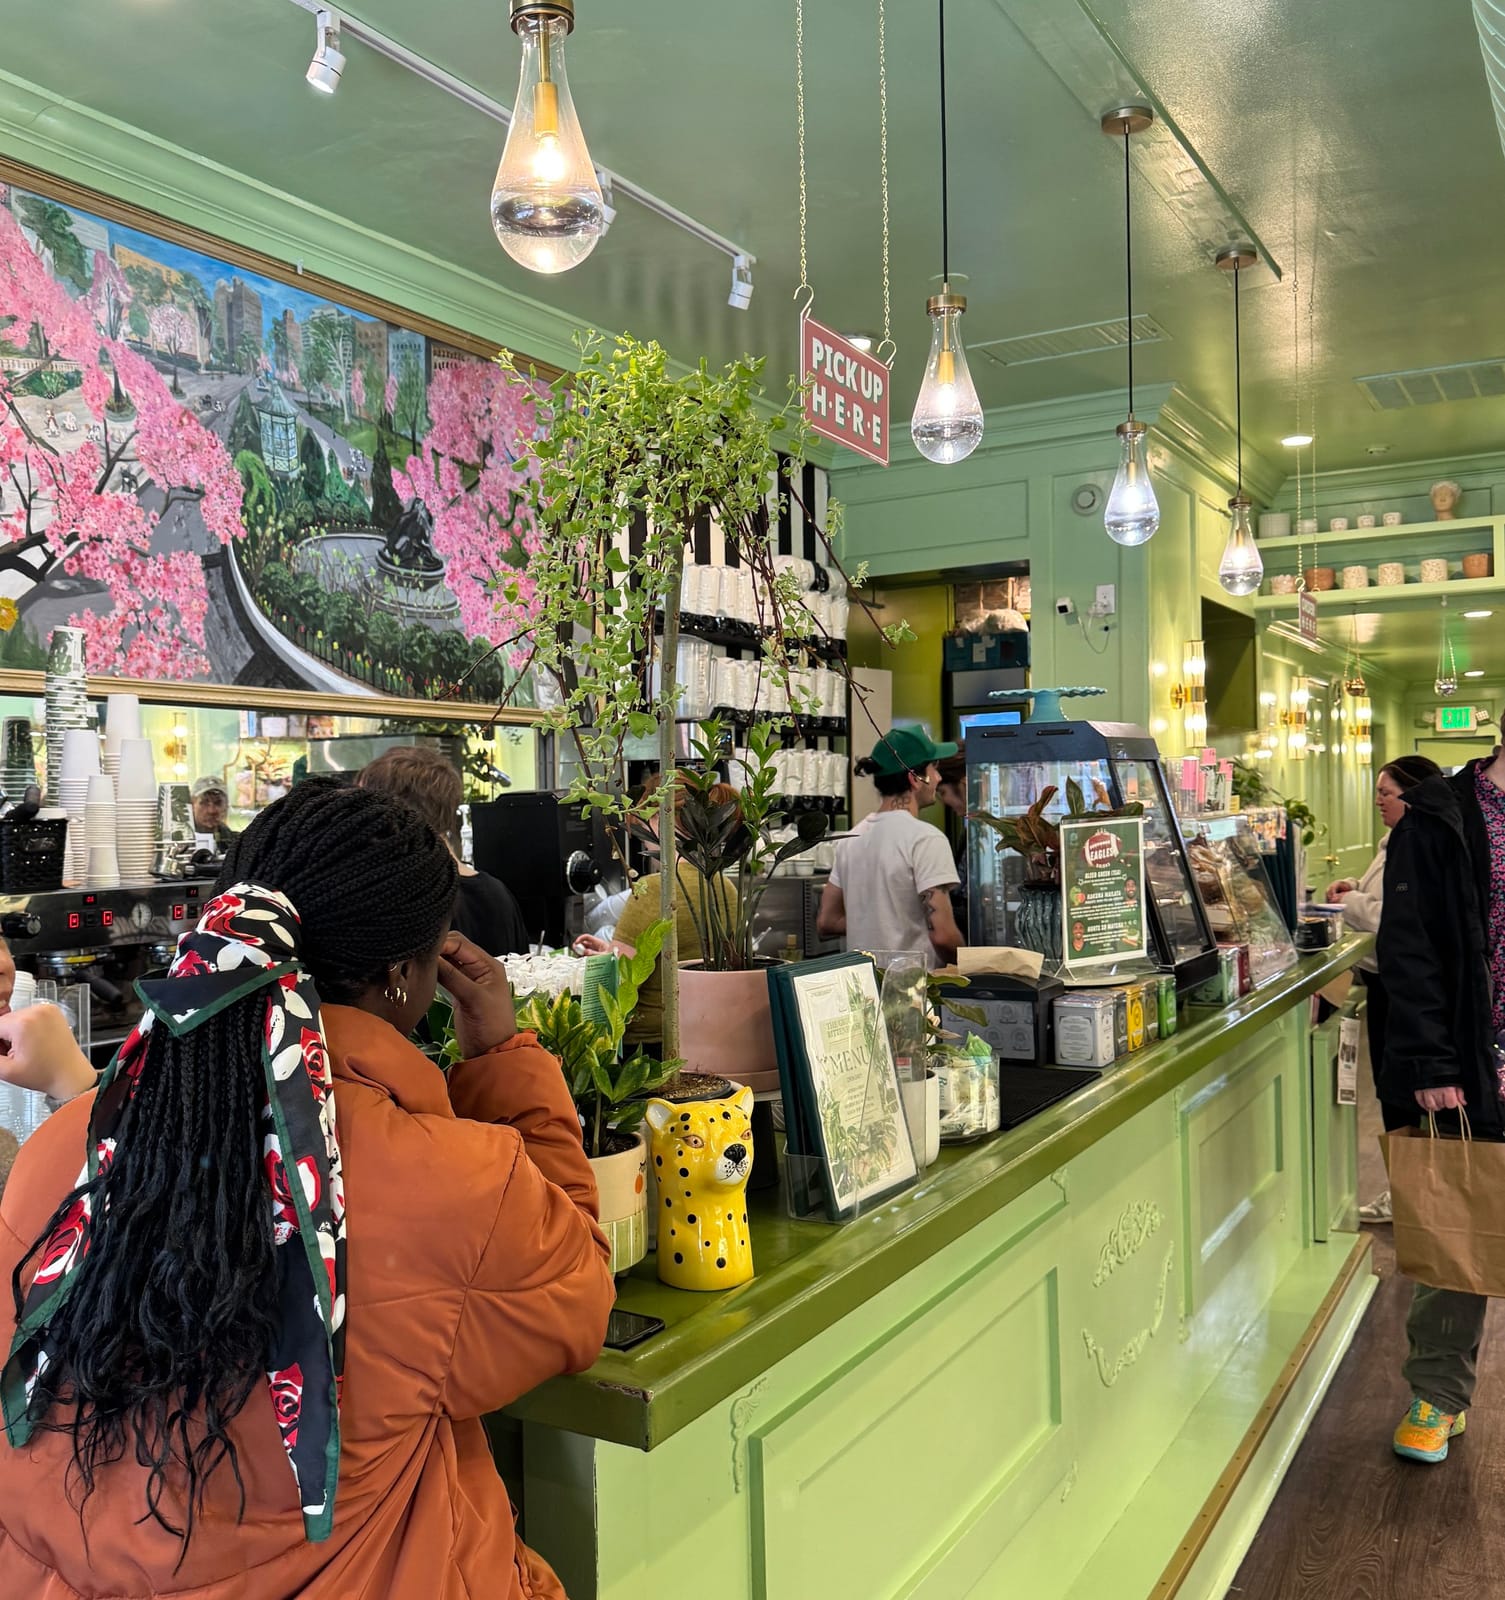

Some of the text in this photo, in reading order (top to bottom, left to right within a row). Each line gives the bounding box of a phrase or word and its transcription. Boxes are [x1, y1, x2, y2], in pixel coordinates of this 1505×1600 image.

[812, 337, 884, 404] PICK UP
[1091, 848, 1114, 861] EAGLES
[829, 1046, 869, 1076] MENU
